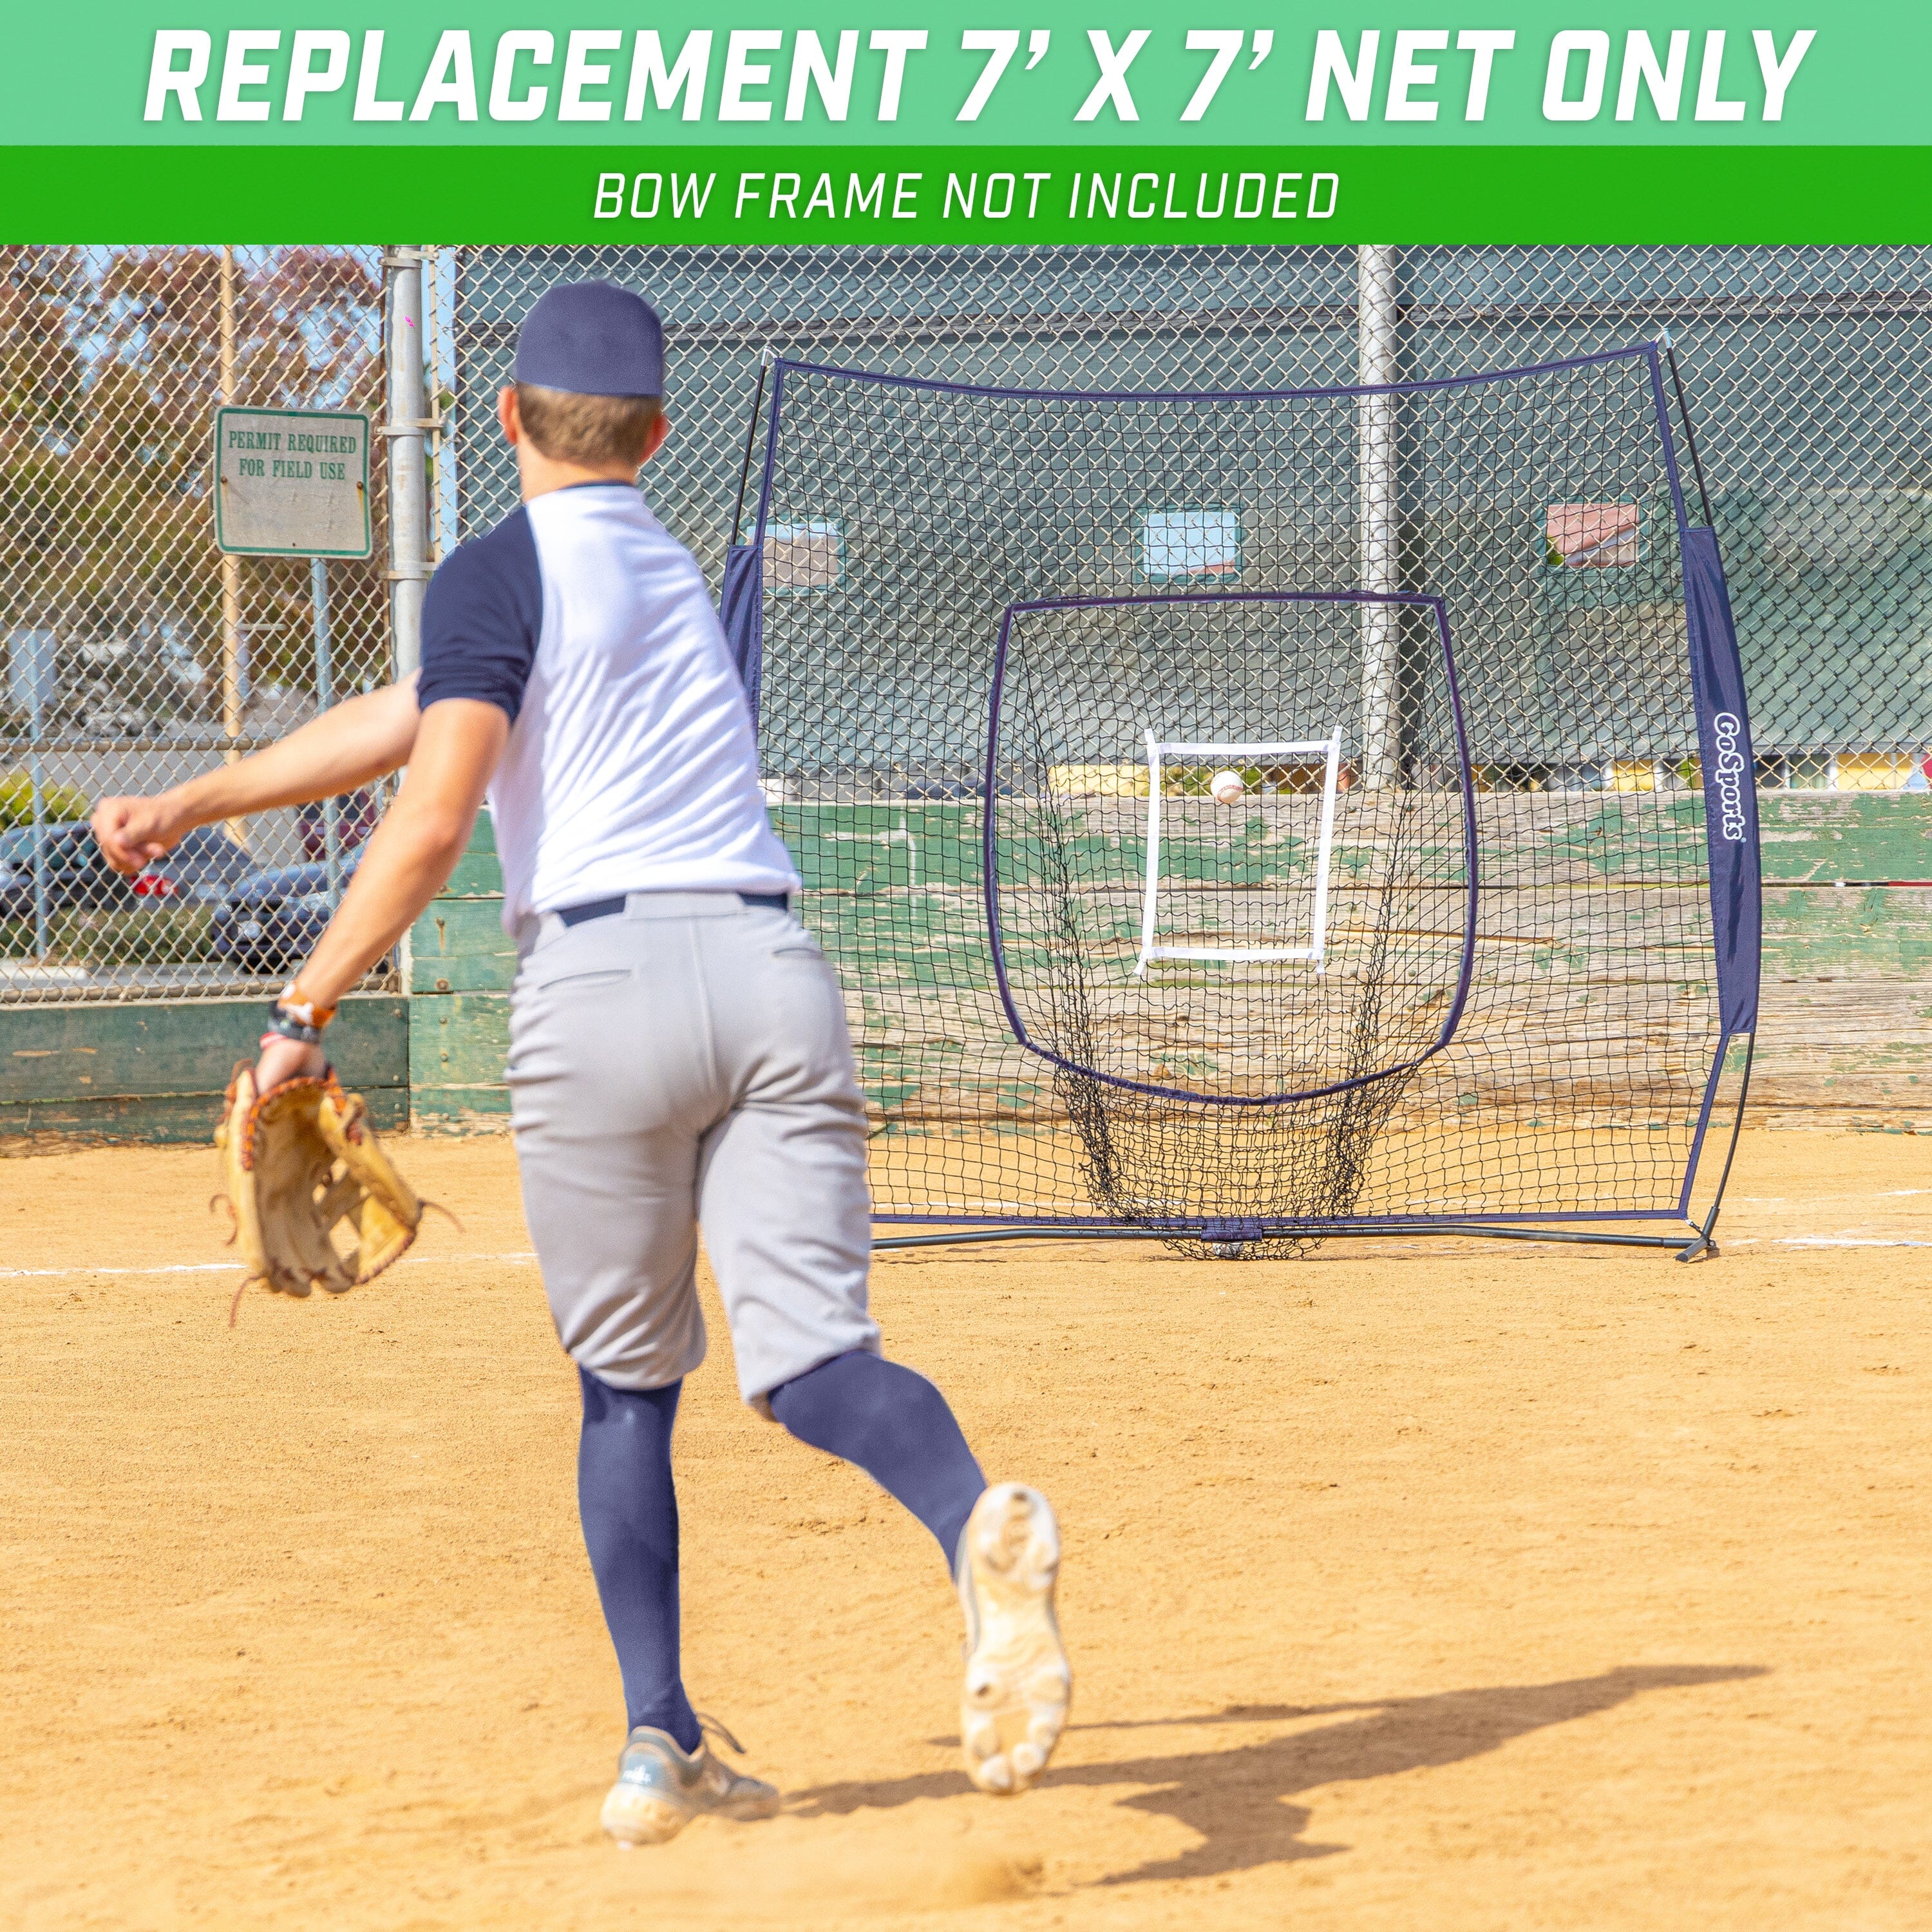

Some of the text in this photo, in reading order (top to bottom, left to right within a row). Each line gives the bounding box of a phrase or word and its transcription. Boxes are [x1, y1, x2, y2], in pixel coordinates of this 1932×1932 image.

[229, 431, 357, 453] PERMIT REQUIRED
[238, 458, 345, 480] FOR FIELD USE
[1714, 712, 1745, 840] GoSports
